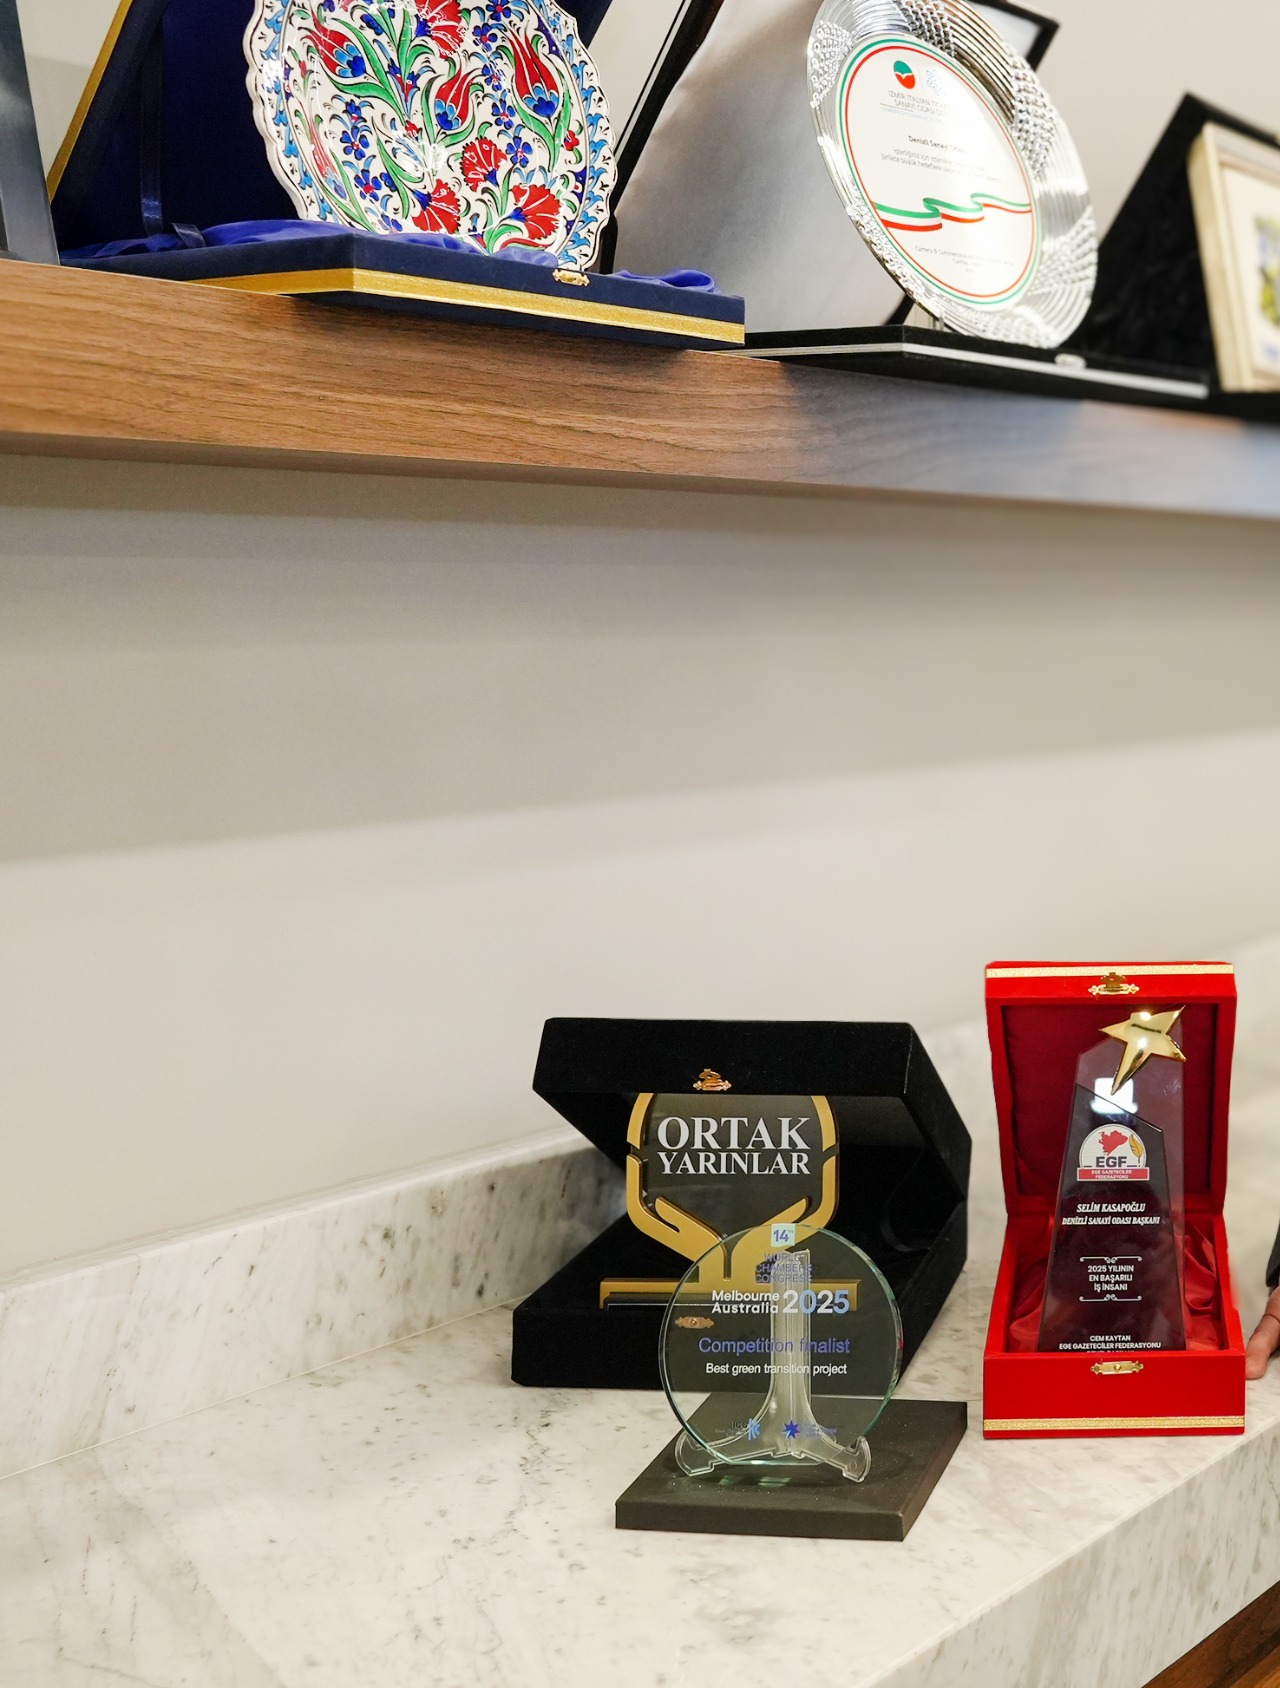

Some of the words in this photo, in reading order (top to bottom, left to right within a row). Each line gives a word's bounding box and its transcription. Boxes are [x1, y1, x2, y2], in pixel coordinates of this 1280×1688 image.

[657, 1116, 811, 1150] ORTAK
[657, 1151, 811, 1175] YARINLAR
[1095, 1156, 1127, 1168] EGF
[1076, 1202, 1101, 1213] SELİM
[1101, 1201, 1146, 1212] KASAPOĞLU
[1061, 1216, 1088, 1225] DENİZLİ
[1088, 1216, 1112, 1225] SANAYİ
[1111, 1216, 1131, 1225] ODASI
[1132, 1216, 1160, 1226] BAŞKANI
[1087, 1264, 1107, 1272] 2025
[1108, 1264, 1134, 1272] YILININ
[1100, 1274, 1133, 1283] BAŞARILI
[1094, 1283, 1101, 1293] İŞ
[1102, 1282, 1128, 1291] İNSANI
[712, 1289, 780, 1301] Melbourne
[711, 1301, 780, 1314] Australia
[782, 1289, 850, 1314] 2025
[698, 1337, 794, 1356] Competition
[799, 1337, 851, 1354] finalist
[705, 1362, 730, 1374] Best
[732, 1364, 761, 1377] green
[764, 1362, 810, 1375] transition
[813, 1363, 848, 1377] project
